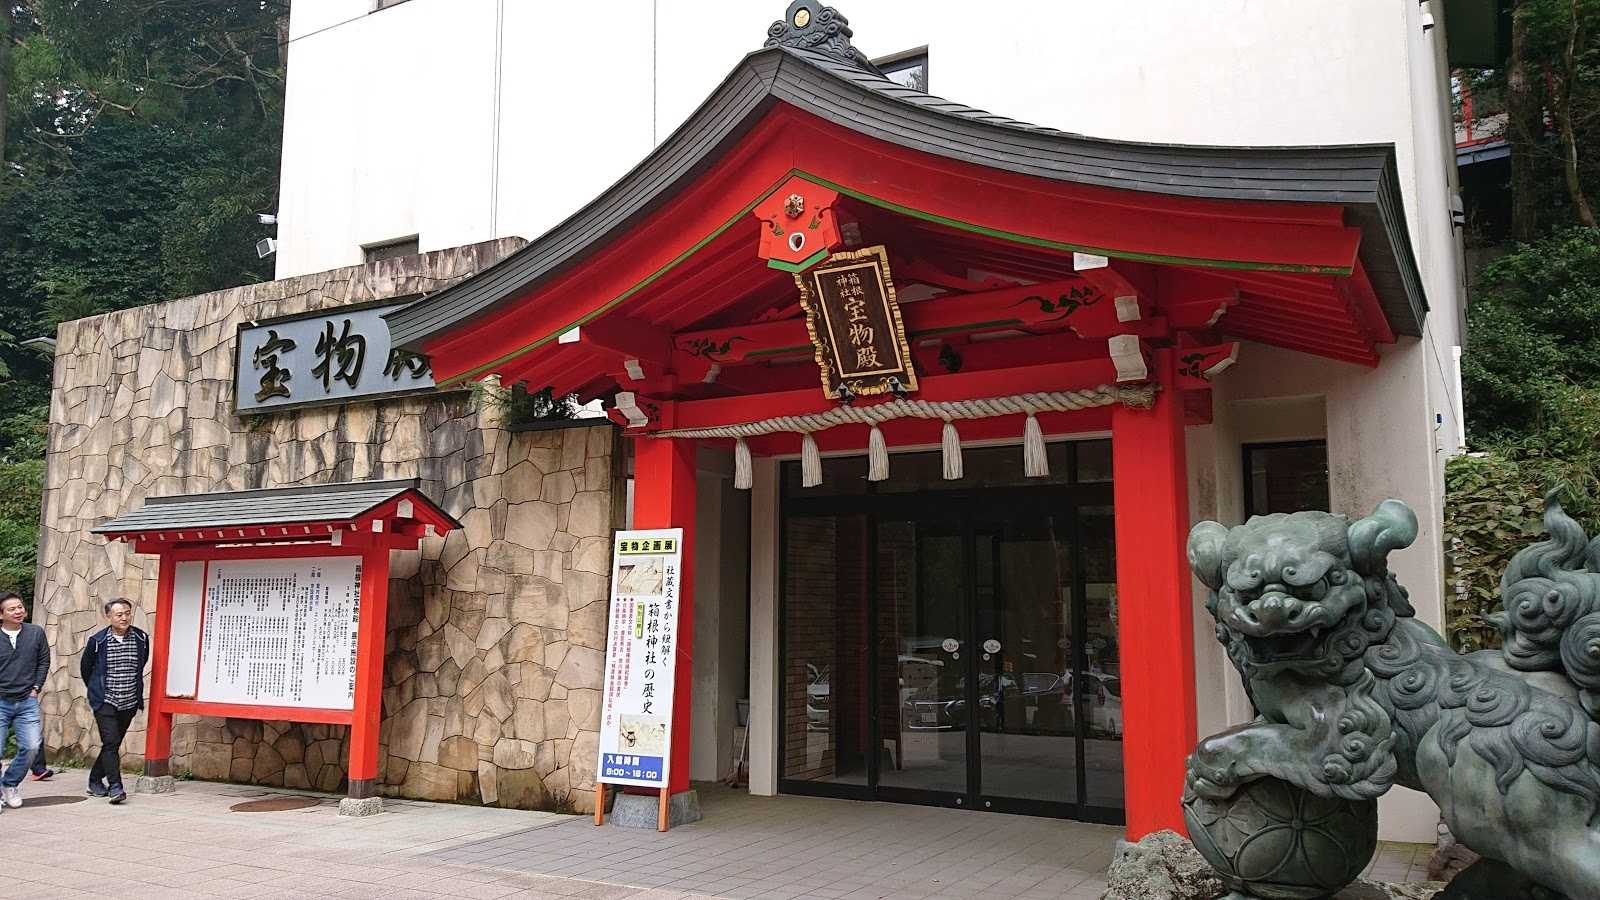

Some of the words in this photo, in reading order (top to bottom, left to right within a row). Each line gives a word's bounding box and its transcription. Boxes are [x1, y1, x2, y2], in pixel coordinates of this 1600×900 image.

[835, 274, 851, 299] 神社
[847, 272, 865, 297] 箱根
[844, 298, 885, 370] 宝物殿
[620, 540, 673, 552] 宝物企画展
[641, 603, 660, 715] 箱根神社の歴史
